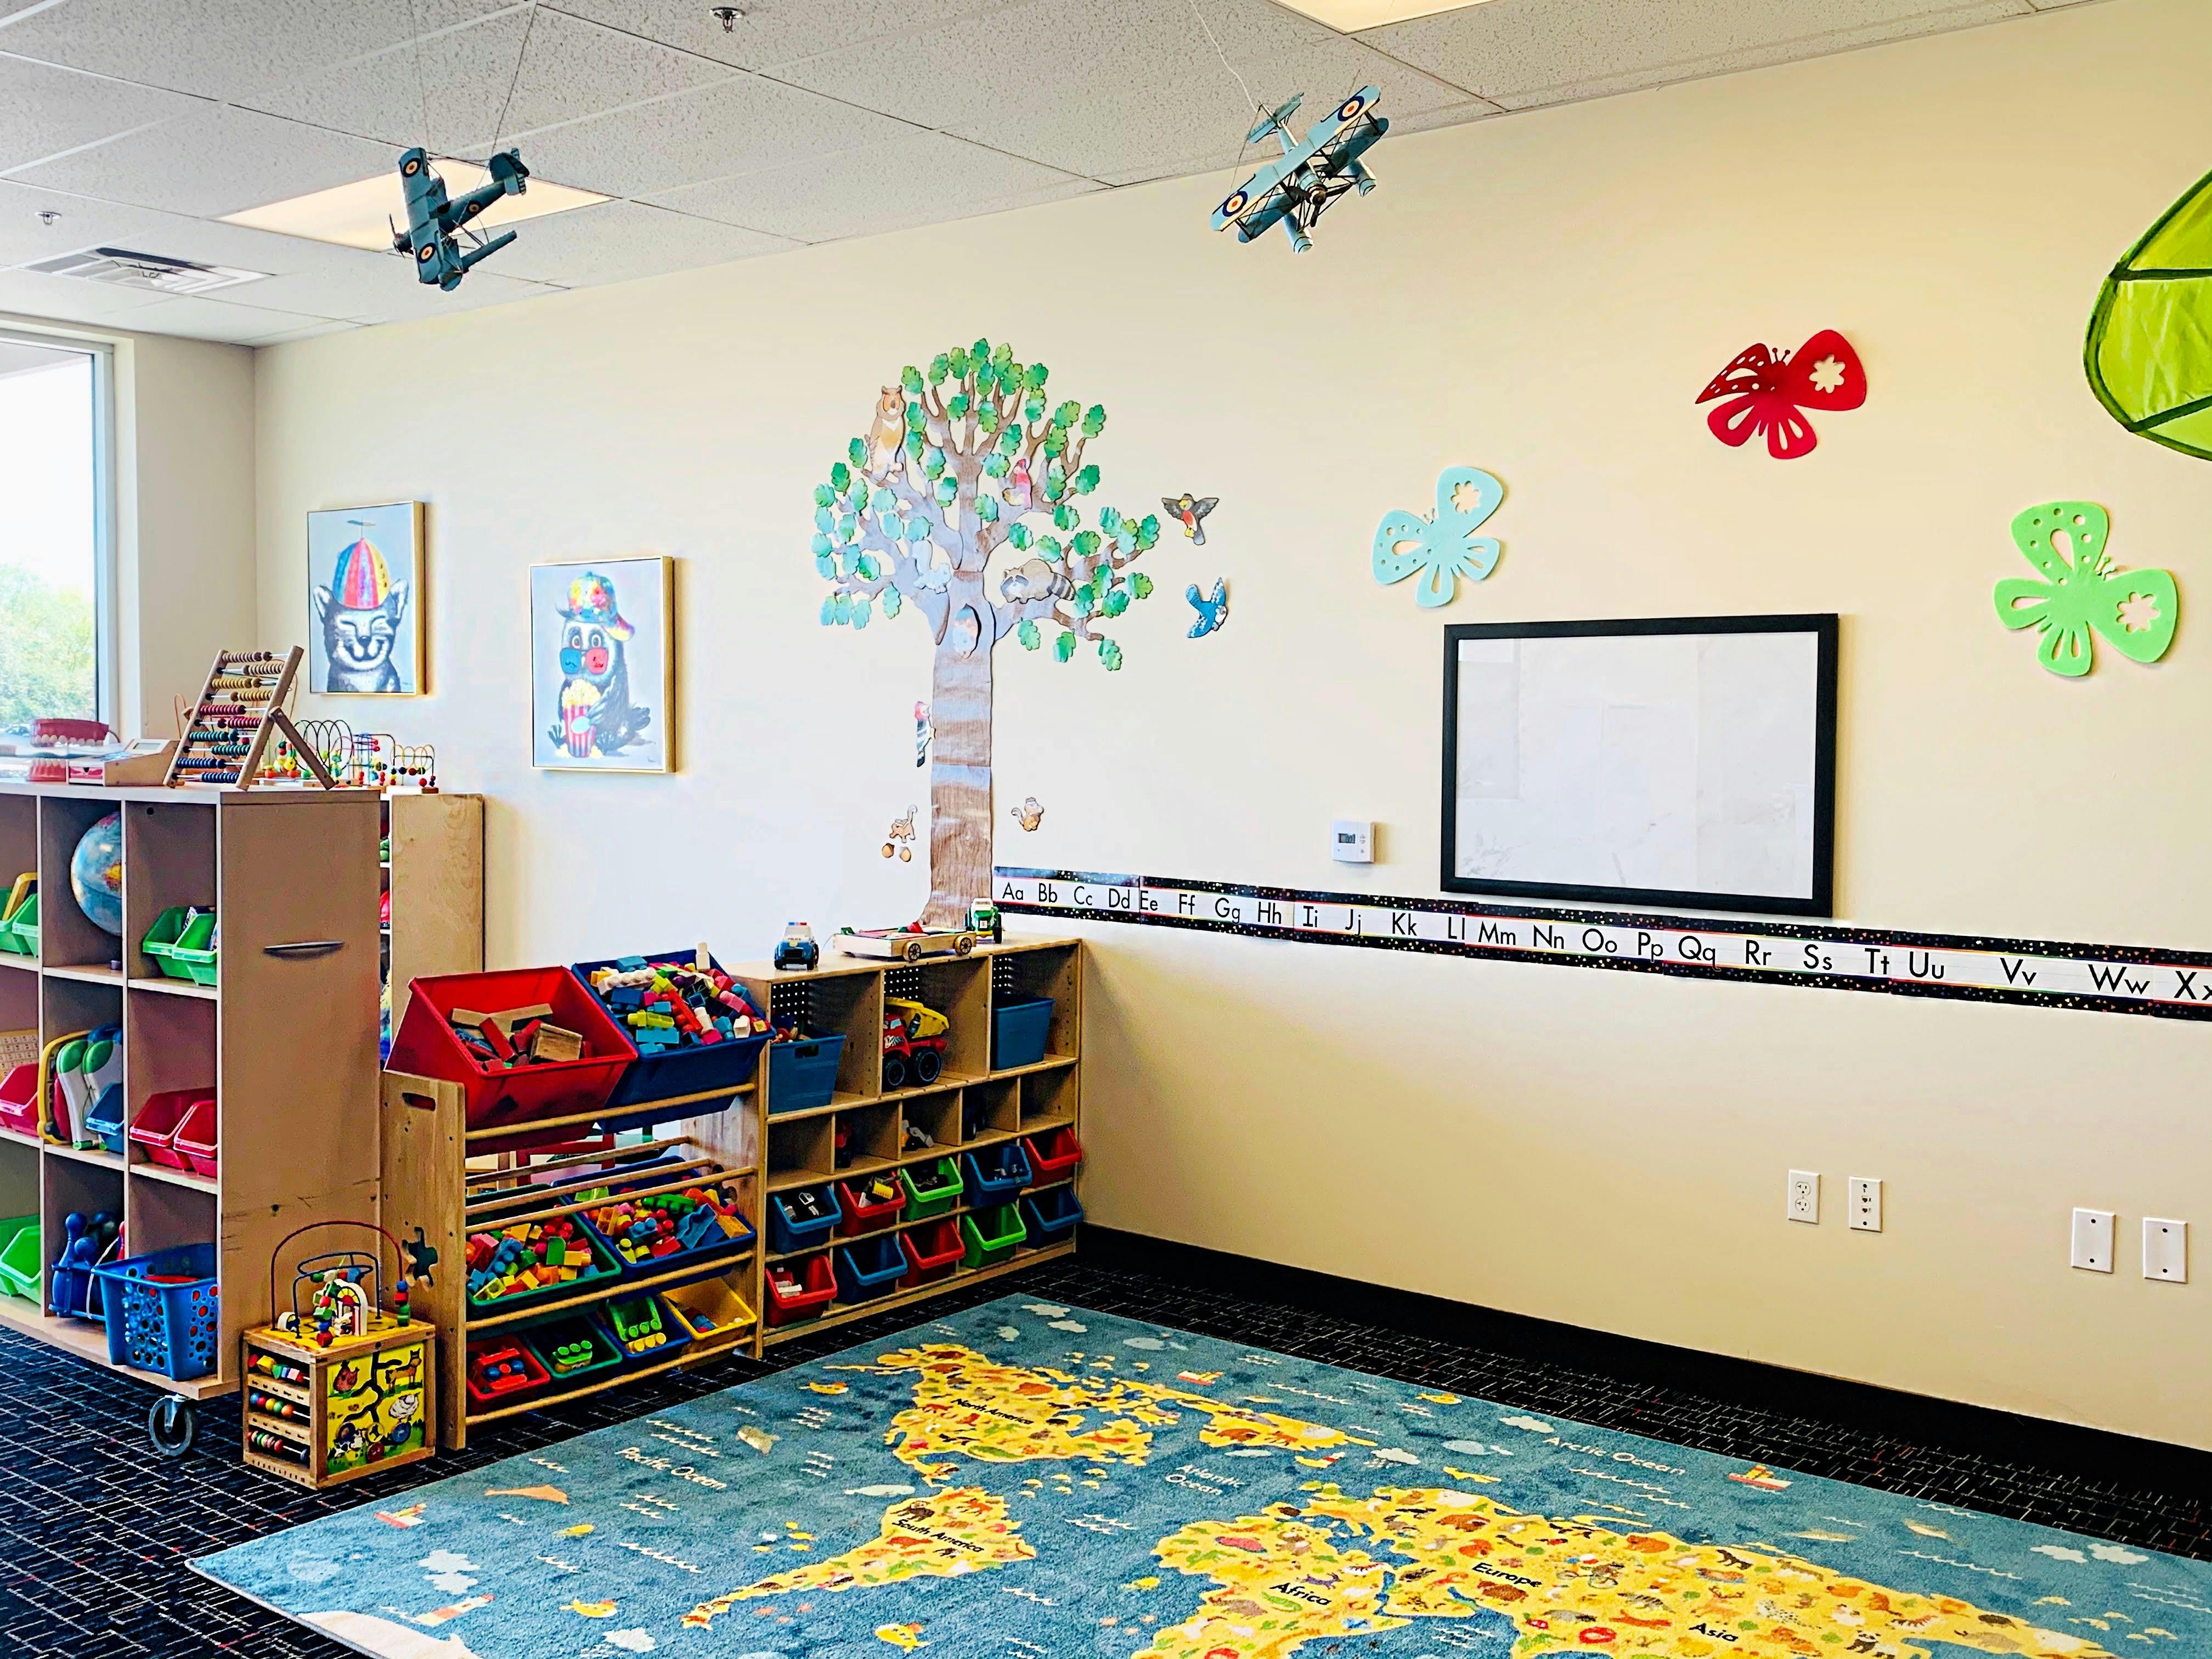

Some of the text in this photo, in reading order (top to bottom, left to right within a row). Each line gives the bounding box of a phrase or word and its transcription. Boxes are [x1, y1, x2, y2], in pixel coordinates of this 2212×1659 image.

[1002, 882, 1024, 900] Aa
[1039, 883, 1058, 902] Bb
[1074, 886, 1092, 906] Cc
[1109, 888, 1130, 909] Dd
[1139, 890, 1158, 911] Ee
[1180, 894, 1195, 915] Ff
[1215, 898, 1241, 924] Gg
[1257, 902, 1282, 924] Hh
[1303, 906, 1318, 927] Ii
[1345, 909, 1362, 936] Jj
[1392, 912, 1417, 936] Kk
[1448, 916, 1465, 940] Ll
[1478, 922, 1516, 945] Mm
[1533, 926, 1564, 949] Nn
[1583, 928, 1617, 953] Oo
[1638, 932, 1663, 963] Pp
[1679, 936, 1722, 972] Qq
[1746, 940, 1772, 966] Rr
[1803, 944, 1832, 970] Ss
[1865, 948, 1890, 975] Tt
[1909, 951, 1944, 979] Uu
[2000, 958, 2037, 986] Vv
[2087, 964, 2151, 995] Ww
[950, 1398, 1034, 1424] North America
[614, 1447, 727, 1490] Pacific Ocean
[1542, 1437, 1686, 1475] Arctic Ocean
[1165, 1474, 1223, 1496] Ocean
[1175, 1464, 1246, 1488] Atlantic
[892, 1519, 985, 1553] South America
[1471, 1562, 1542, 1587] Europe
[1269, 1582, 1332, 1605] Africa
[1688, 1623, 1739, 1642] Asia
